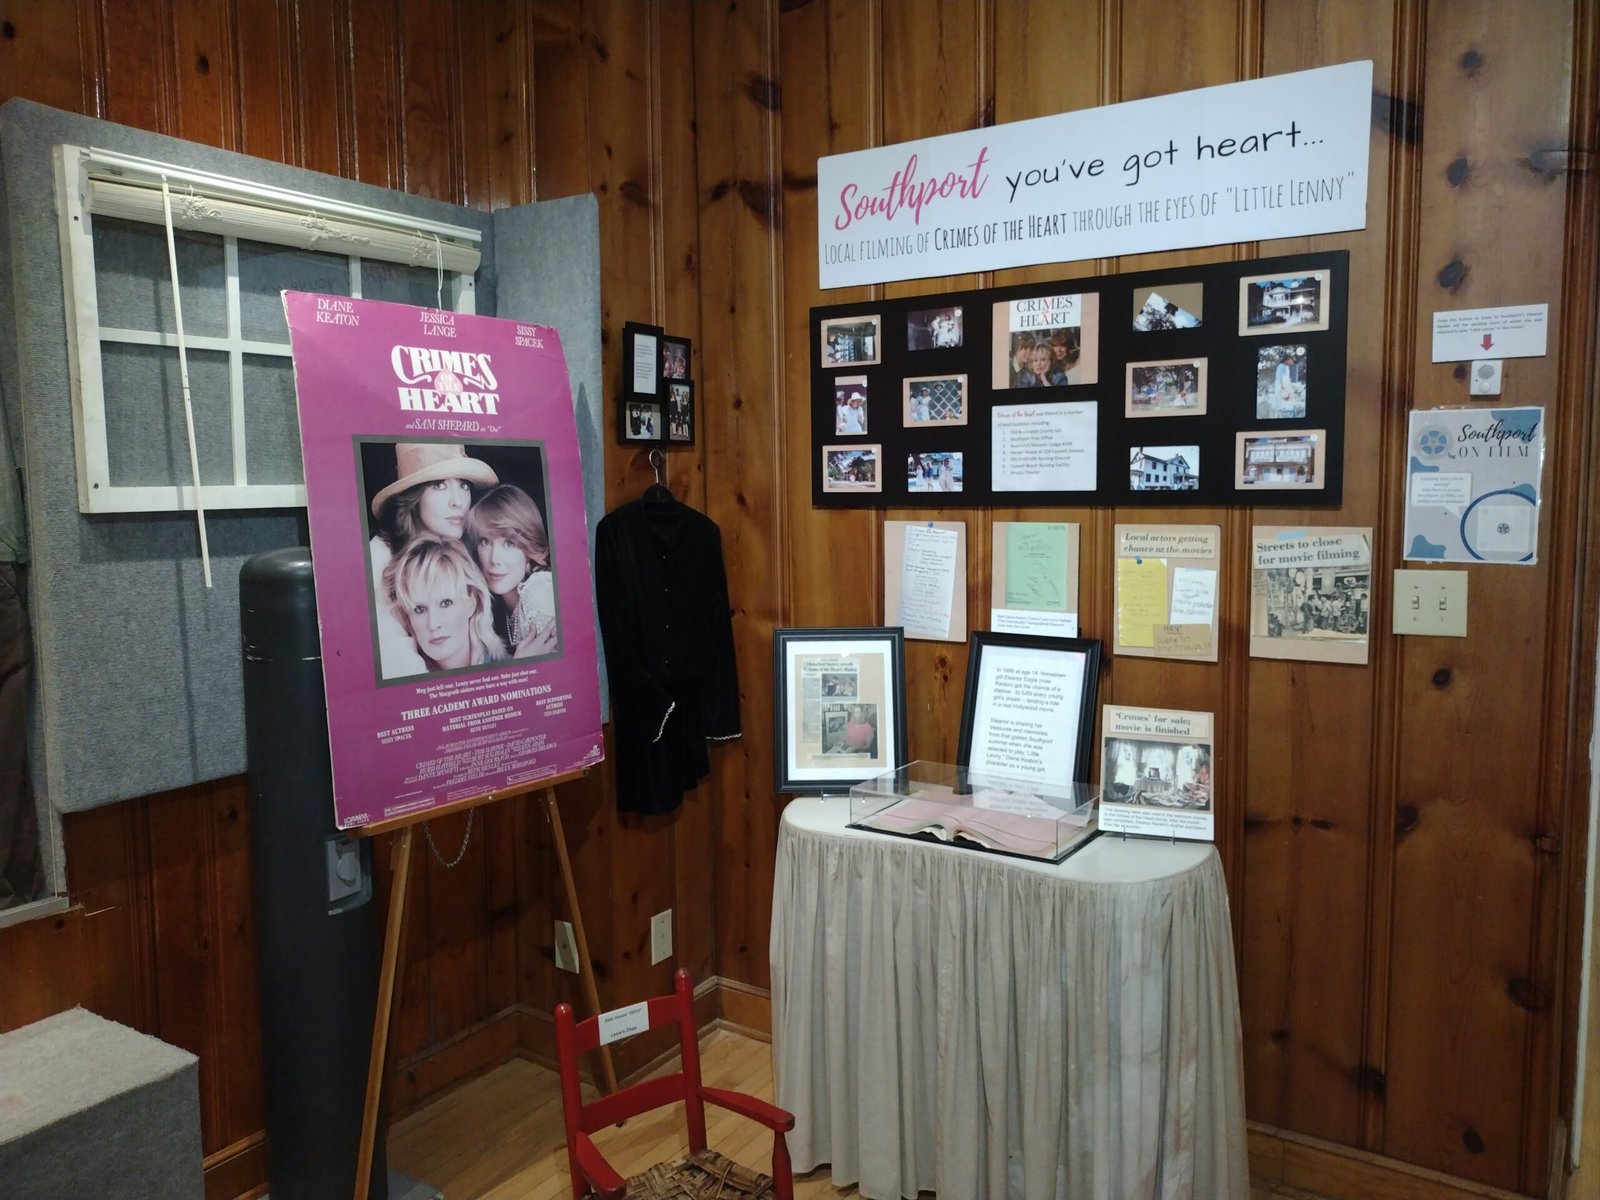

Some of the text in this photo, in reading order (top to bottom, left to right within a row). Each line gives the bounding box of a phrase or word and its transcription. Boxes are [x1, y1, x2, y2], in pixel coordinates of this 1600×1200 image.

[834, 121, 1324, 231] Southport you've got heart...
[859, 235, 913, 261] FILMING
[917, 232, 930, 253] OF
[983, 223, 998, 245] OF
[1003, 219, 1023, 242] THE
[1073, 203, 1132, 232] THROUGH
[1138, 200, 1160, 223] THE
[1165, 195, 1195, 221] EYES
[1201, 192, 1218, 216] OF
[317, 298, 354, 314] DIANE
[1016, 296, 1073, 313] CRIMES
[316, 311, 360, 327] KEATON
[420, 311, 455, 326] JESSICA
[1020, 311, 1070, 328] HEART
[424, 324, 457, 338] LANGE
[516, 325, 536, 337] SISSY
[515, 336, 544, 349] SPACEK
[391, 345, 498, 391] CRIMES
[397, 386, 500, 415] HEART
[415, 418, 436, 430] SAM
[438, 419, 480, 432] SHEPARD
[1457, 419, 1538, 447] Southport
[1459, 445, 1529, 458] ON FILM
[1125, 532, 1209, 544] Local actors getting
[1257, 537, 1342, 553] Streets to close
[1124, 544, 1212, 554] chance at the movies
[1258, 548, 1360, 565] for movie filming
[400, 684, 552, 721] THREE ACADEMY AWARD NOMINATIONS
[1013, 703, 1038, 711] Hollywood
[442, 722, 466, 732] MATERIAL
[467, 718, 481, 727] FROM
[482, 714, 504, 724] ANOTHER
[1115, 711, 1151, 722] 'Crimes'
[1154, 713, 1166, 723] for
[377, 725, 415, 738] BEST ACTRESS
[1115, 723, 1190, 736] movie is finished
